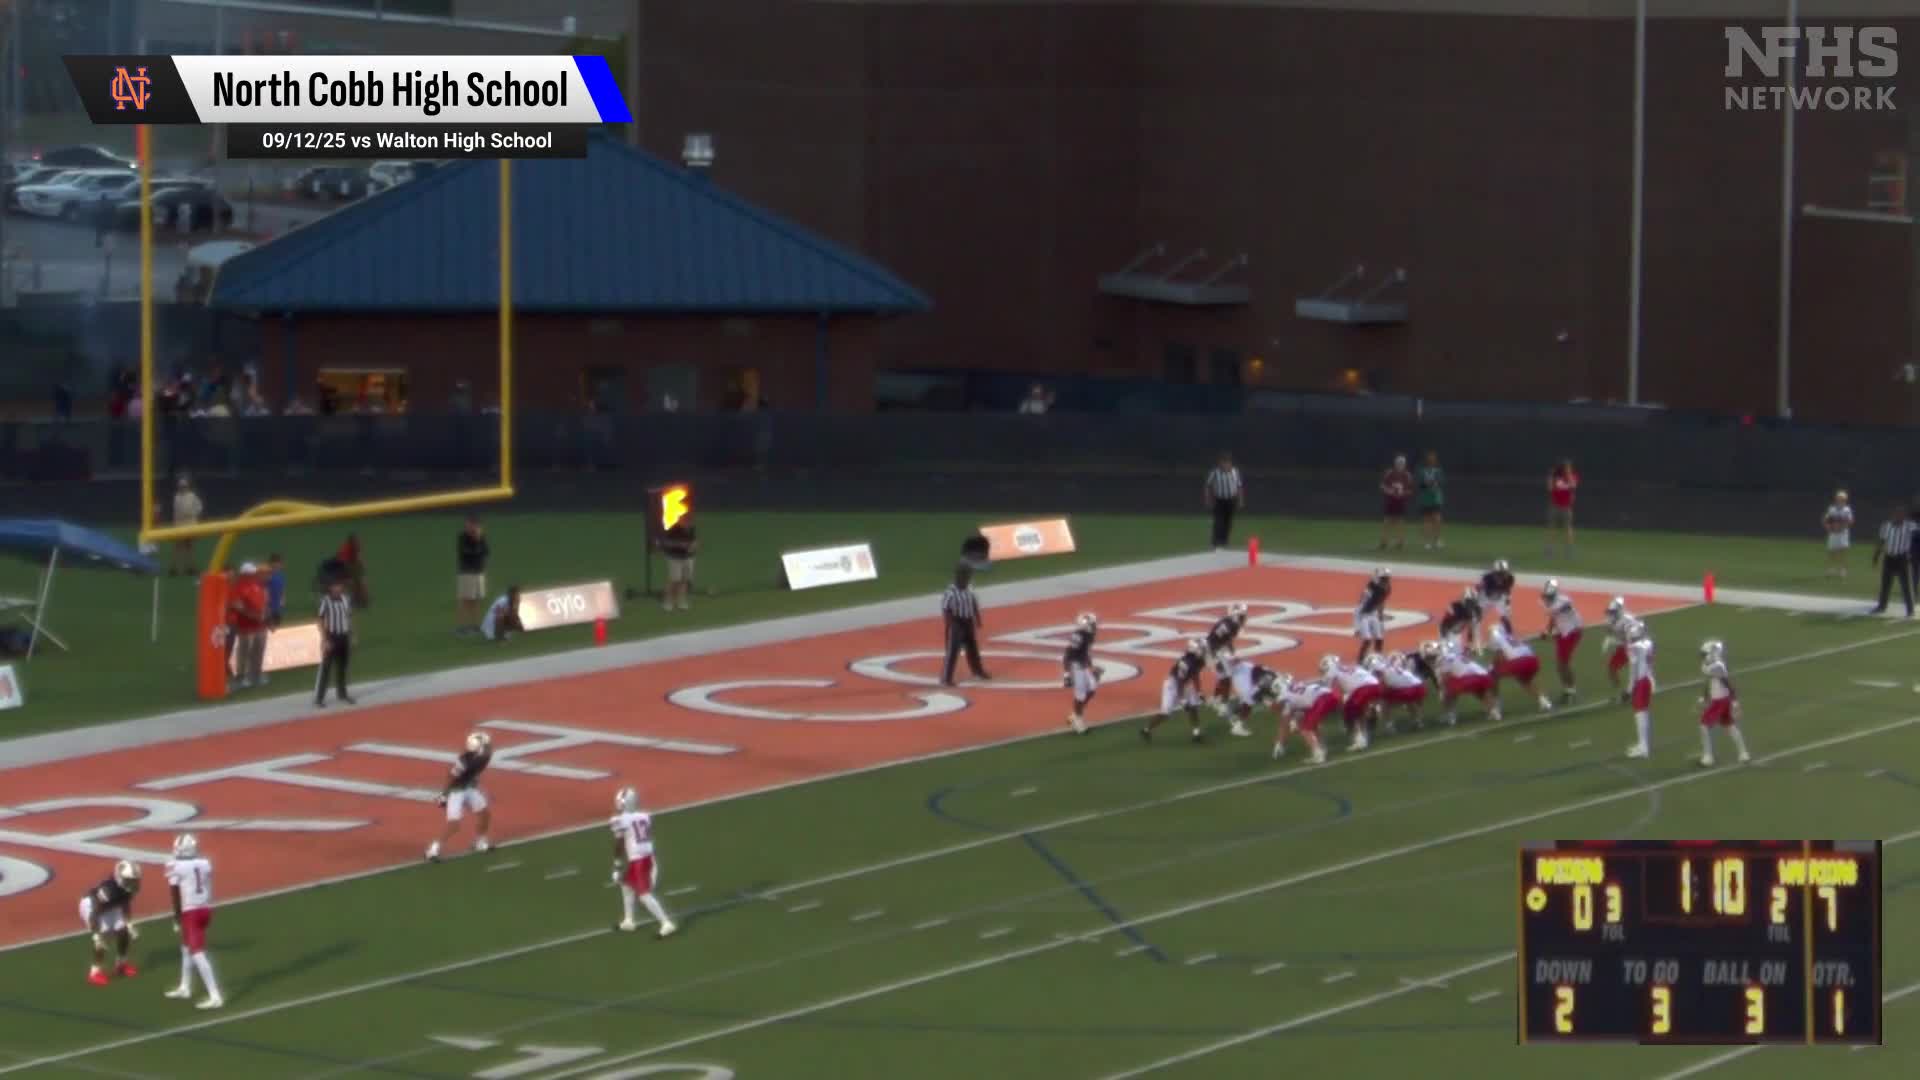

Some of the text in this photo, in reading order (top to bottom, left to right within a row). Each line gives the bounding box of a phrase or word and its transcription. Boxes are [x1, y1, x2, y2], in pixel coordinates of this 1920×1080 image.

[1573, 886, 1593, 930] 0
[1605, 885, 1621, 922] 3
[1770, 887, 1787, 924] 2
[1818, 887, 1837, 931] 7
[1535, 960, 1592, 984] DOWN
[1623, 961, 1680, 984] TO GO
[1703, 961, 1787, 985] BALL ON
[1555, 986, 1574, 1033] 2
[1651, 986, 1671, 1033] 3
[1744, 986, 1764, 1033] 3
[1834, 989, 1845, 1034] 1
